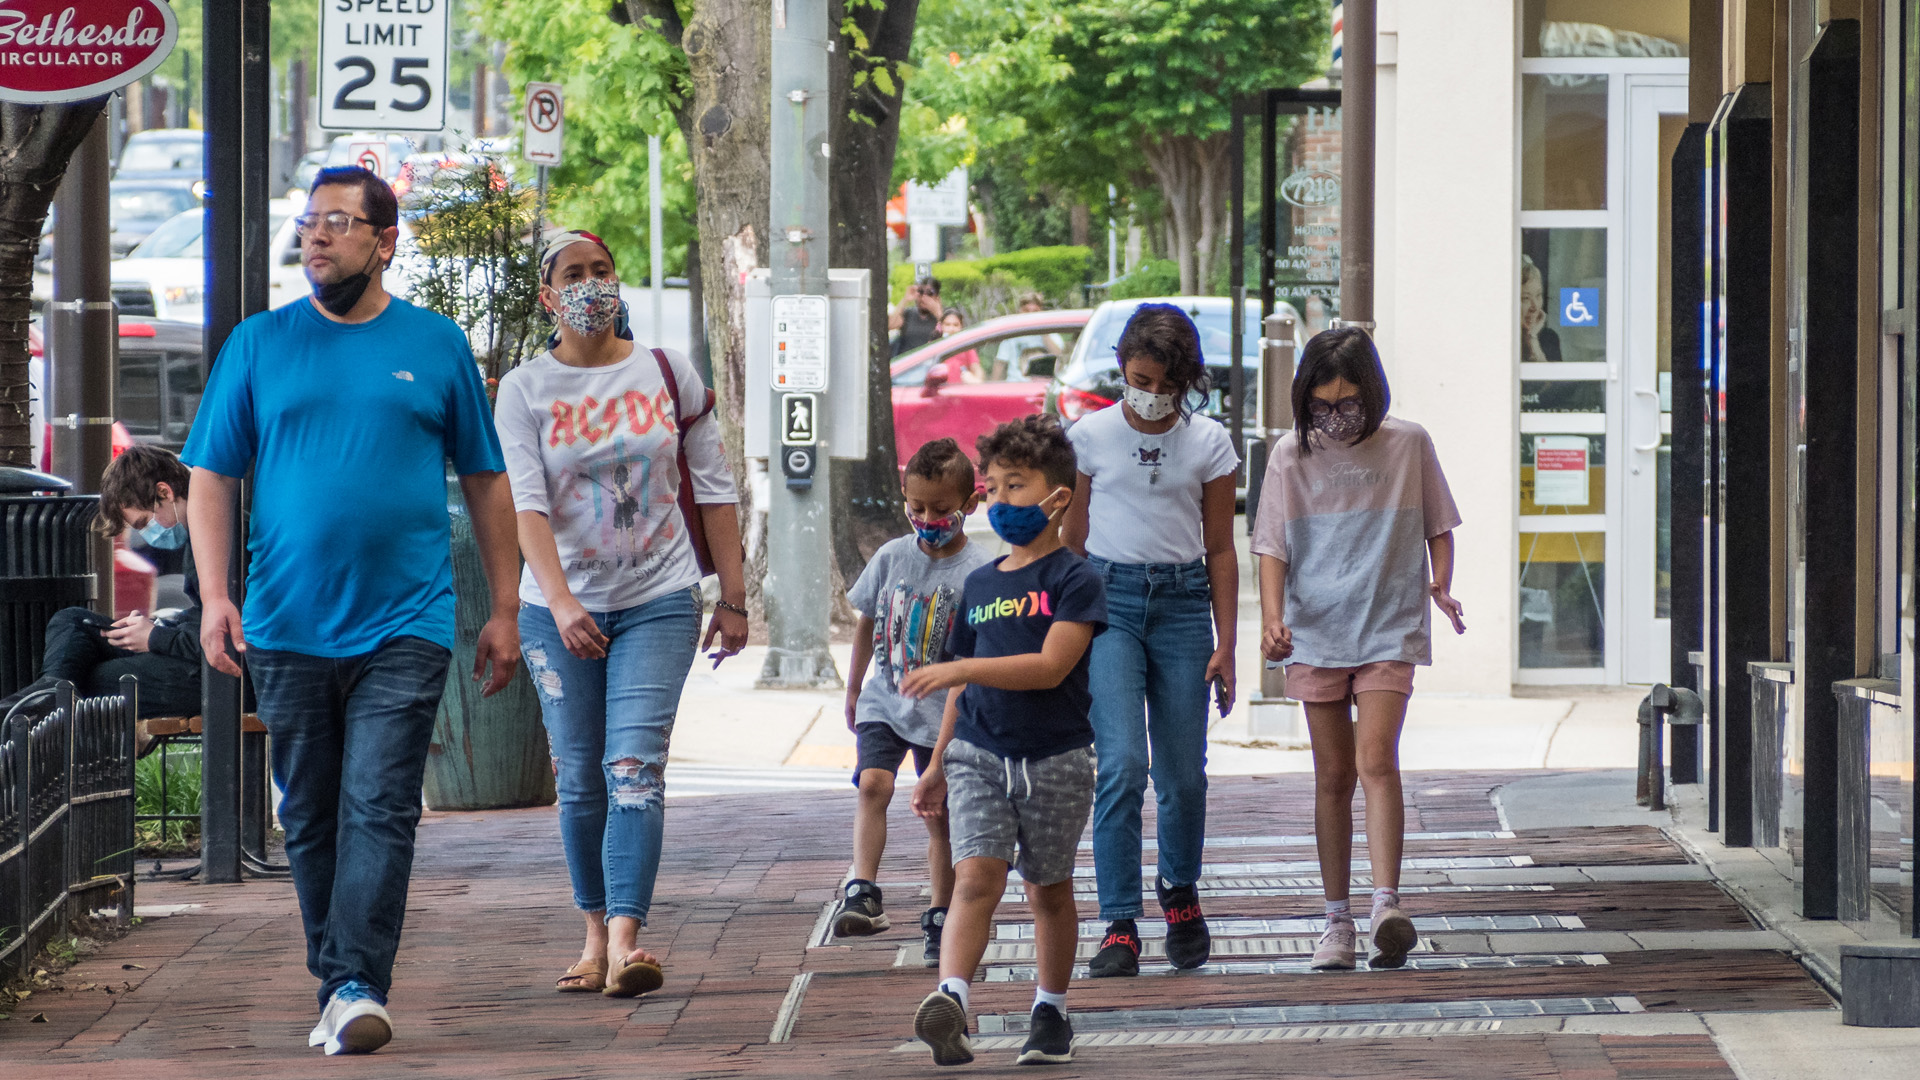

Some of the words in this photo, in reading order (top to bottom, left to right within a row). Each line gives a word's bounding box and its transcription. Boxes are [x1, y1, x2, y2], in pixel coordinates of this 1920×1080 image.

[336, 0, 434, 14] SPEED
[0, 7, 164, 46] Bethesda
[346, 23, 422, 46] LIMIT
[1, 52, 123, 65] IRCULATOR
[333, 56, 431, 112] 25
[1288, 176, 1337, 202] 7219
[567, 560, 610, 571] FLICK
[967, 596, 1028, 626] Hurley
